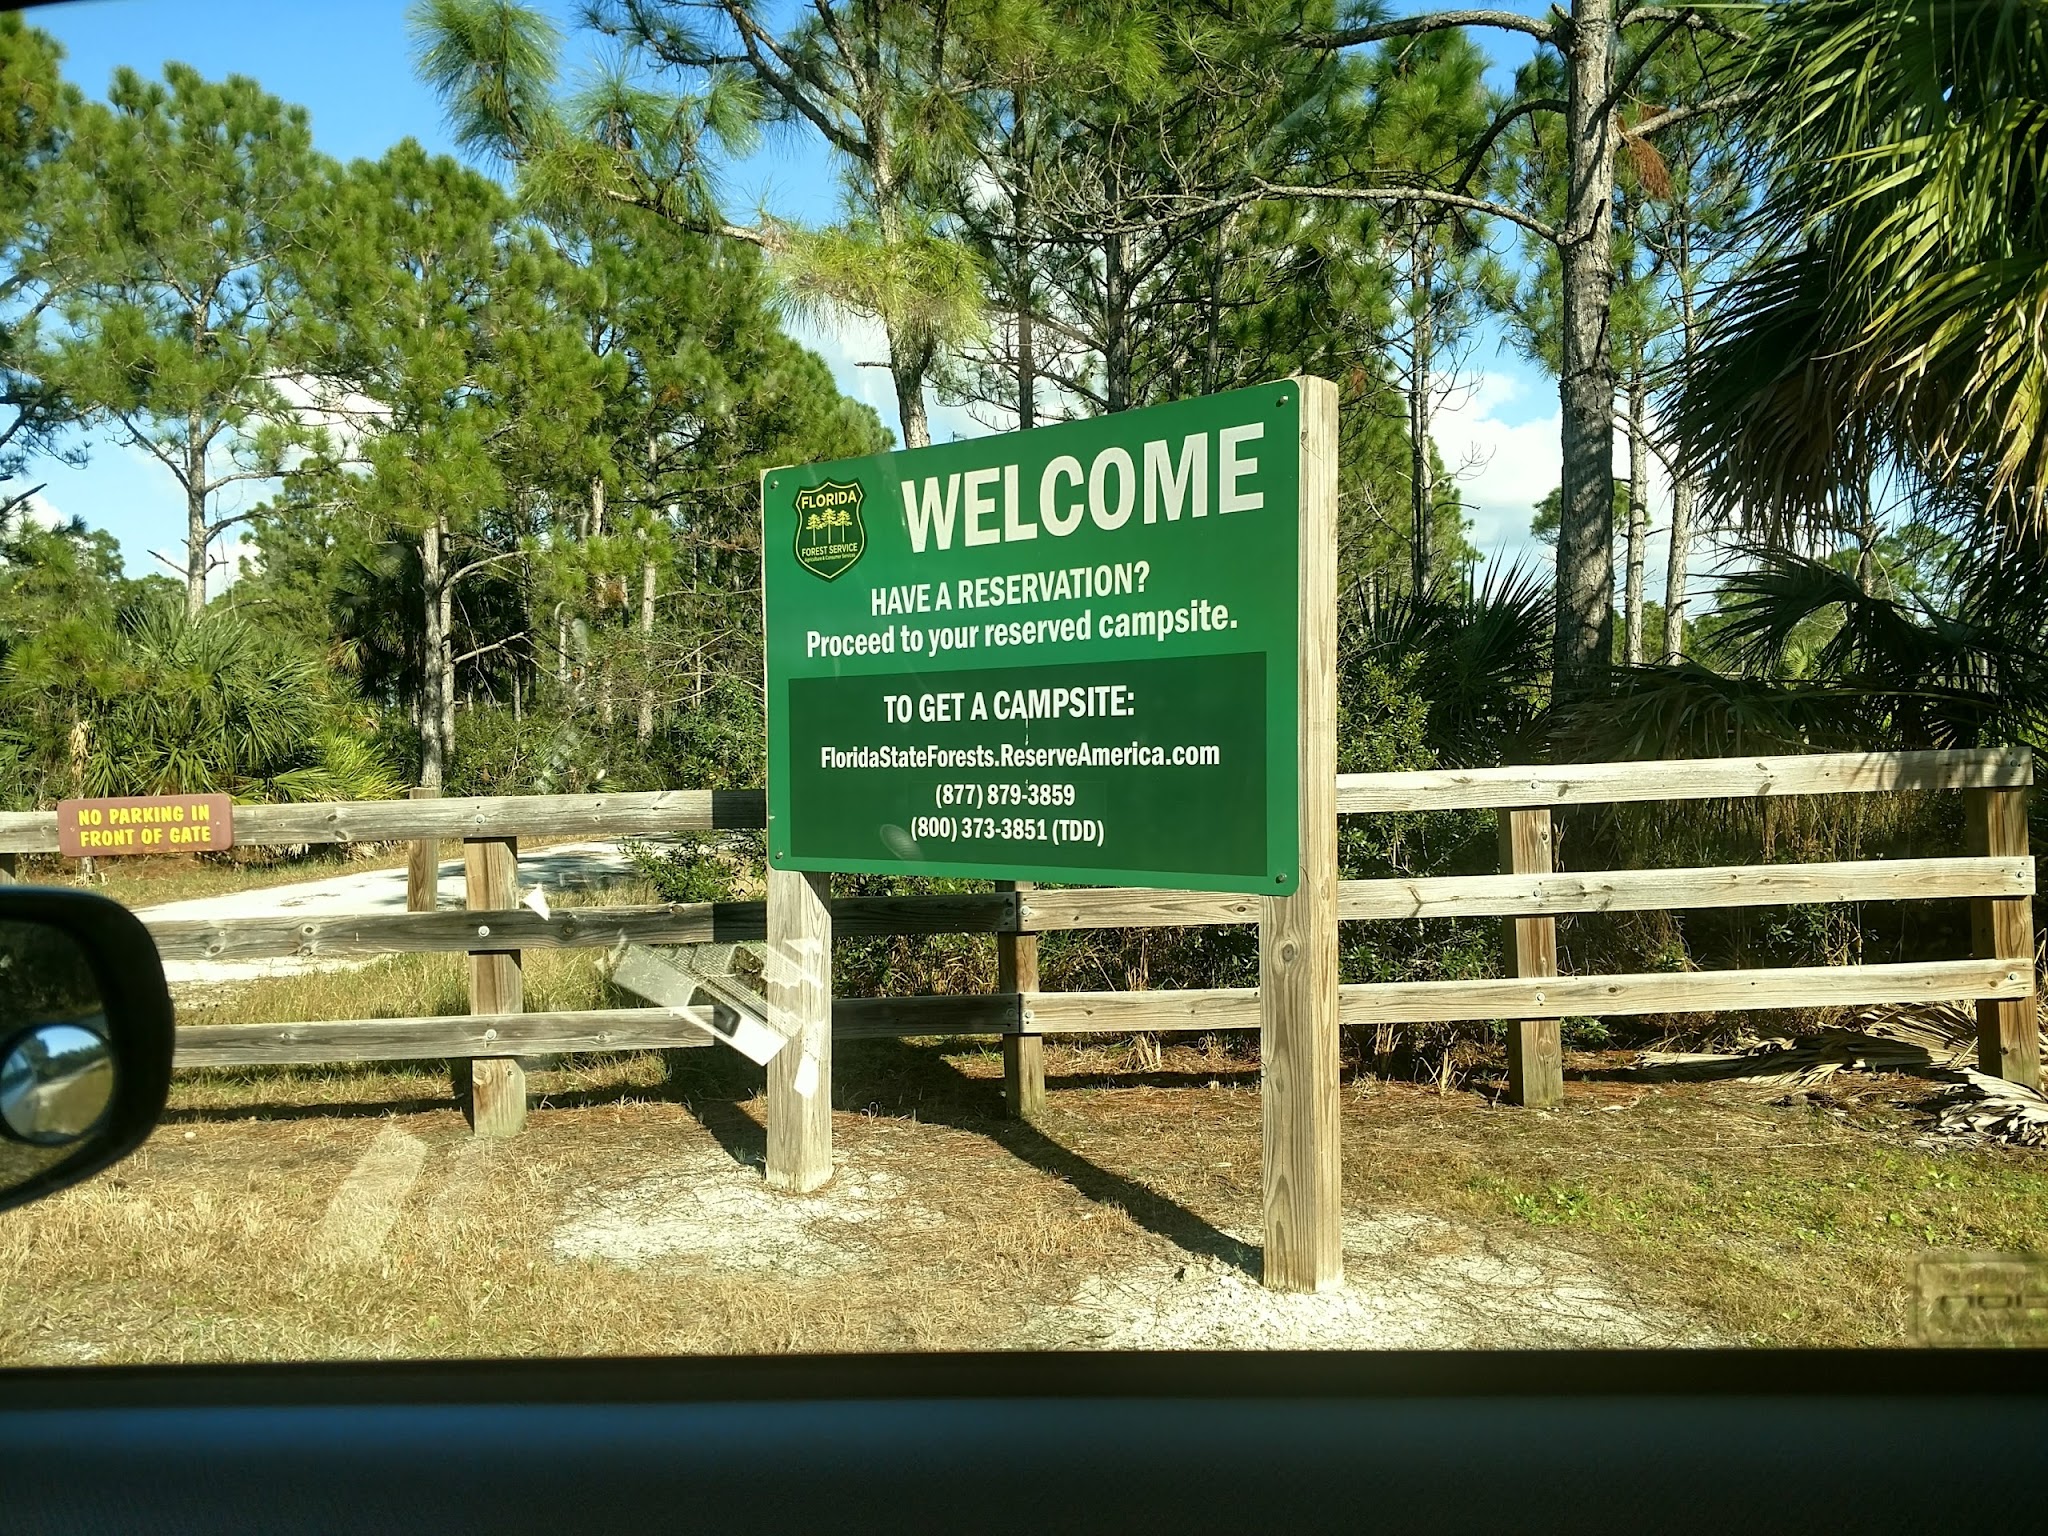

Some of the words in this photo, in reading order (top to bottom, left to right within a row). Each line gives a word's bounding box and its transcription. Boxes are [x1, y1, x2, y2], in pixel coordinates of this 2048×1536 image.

[801, 490, 857, 509] FLORIDA
[901, 422, 1264, 553] WELCOME
[801, 545, 828, 557] FOREST
[829, 543, 858, 554] SERVICE
[871, 583, 931, 616] HAVE
[935, 582, 952, 611] A
[958, 560, 1150, 609] RESERVATION?
[807, 625, 895, 658] Proceed
[901, 625, 923, 652] to
[928, 625, 979, 657] your
[985, 609, 1091, 647] reserved
[1098, 599, 1238, 641] campsite.
[883, 695, 913, 723] TO
[919, 692, 965, 722] GET
[970, 691, 988, 720] A
[993, 685, 1135, 720] CAMPSITE:
[821, 740, 1220, 768] FloridaStateForests.ReserveAmerica.com
[935, 784, 983, 809] (877)
[987, 784, 1075, 806] 879-3859
[78, 809, 102, 826] NO
[109, 805, 184, 825] PARKING
[191, 804, 210, 821] IN
[80, 829, 135, 848] FRONT
[140, 827, 163, 845] OF
[169, 826, 211, 844] GATE
[911, 817, 957, 842] (800)
[961, 818, 1048, 840] 373-3851
[1052, 819, 1104, 847] (TDD)
